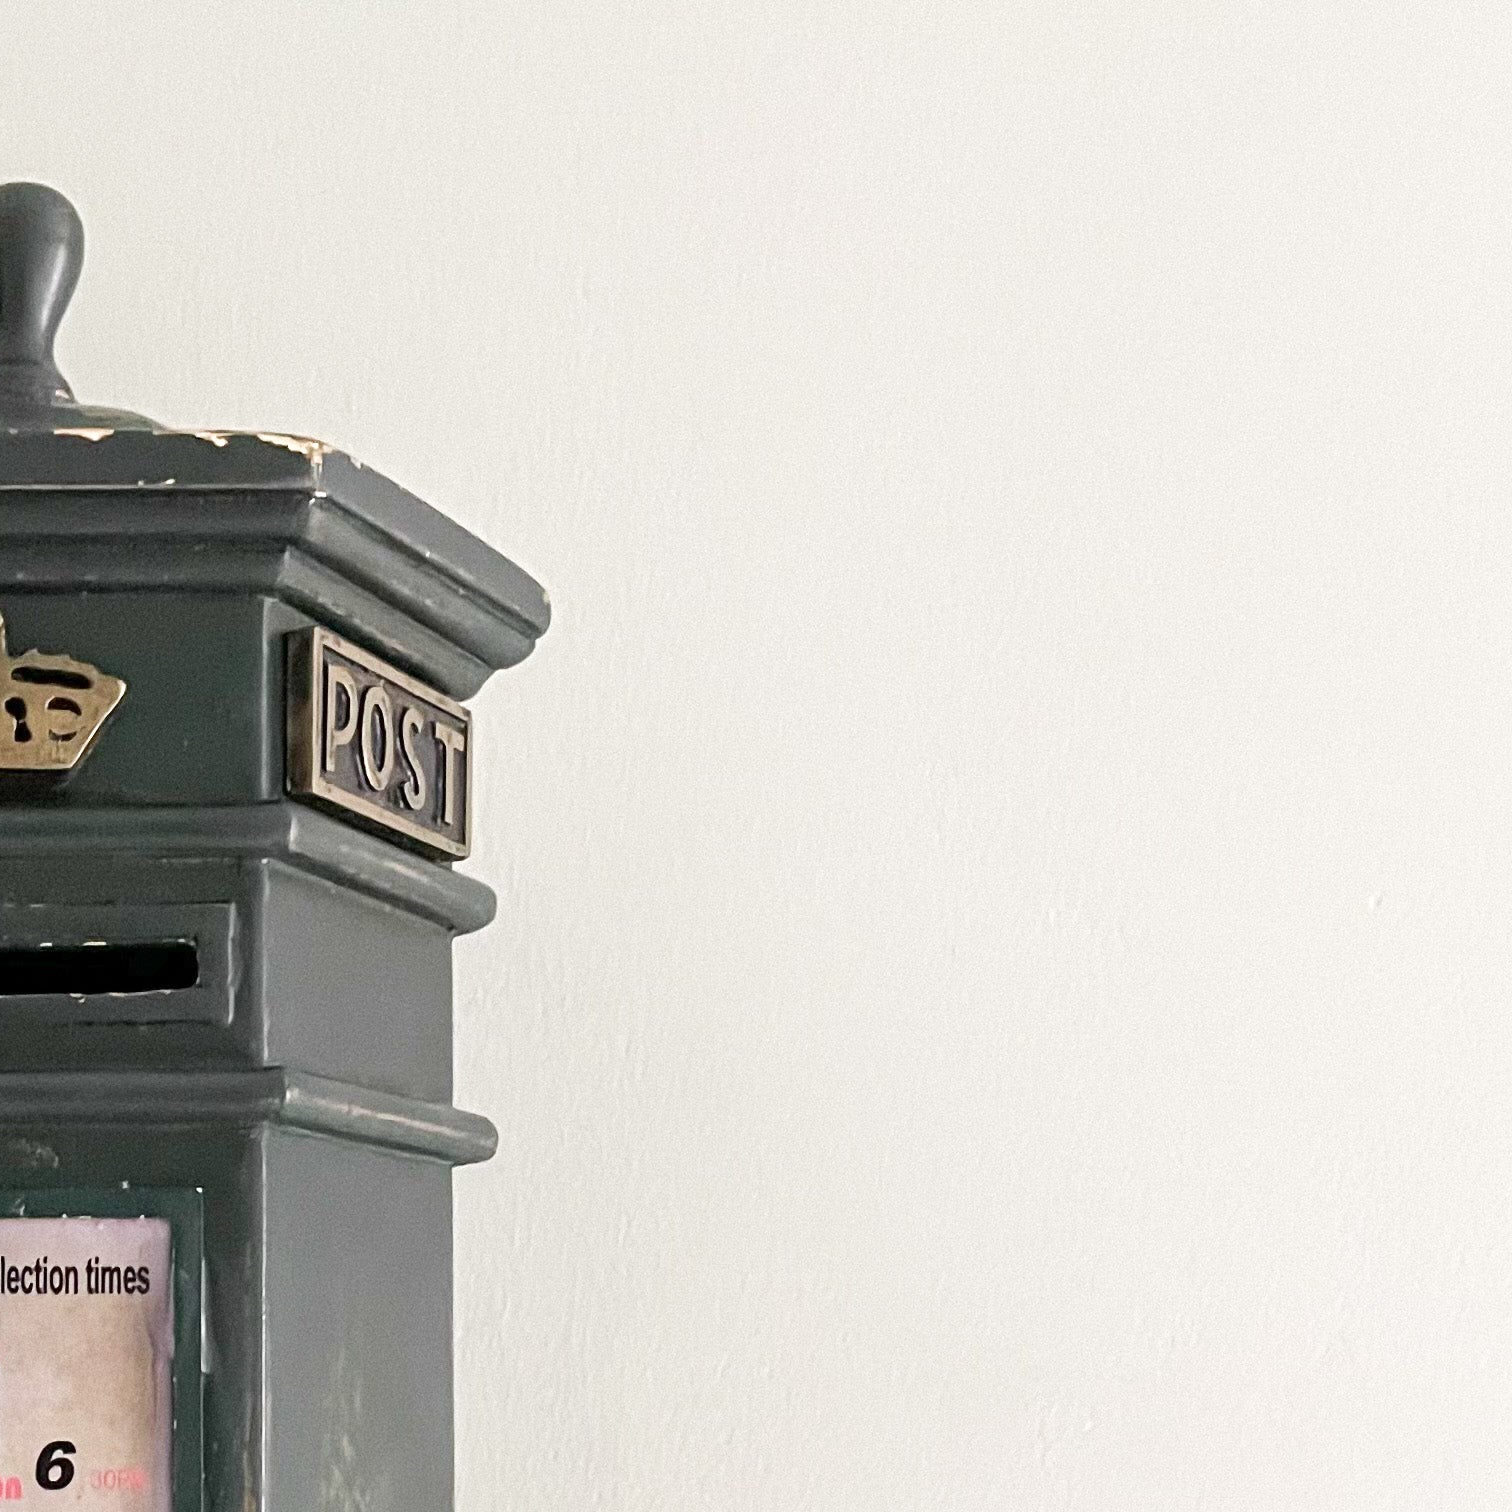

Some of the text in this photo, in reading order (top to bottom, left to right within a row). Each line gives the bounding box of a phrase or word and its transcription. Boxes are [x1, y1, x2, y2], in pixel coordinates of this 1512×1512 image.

[326, 664, 465, 826] POST
[85, 1256, 151, 1296] times
[35, 1440, 77, 1491] 6
